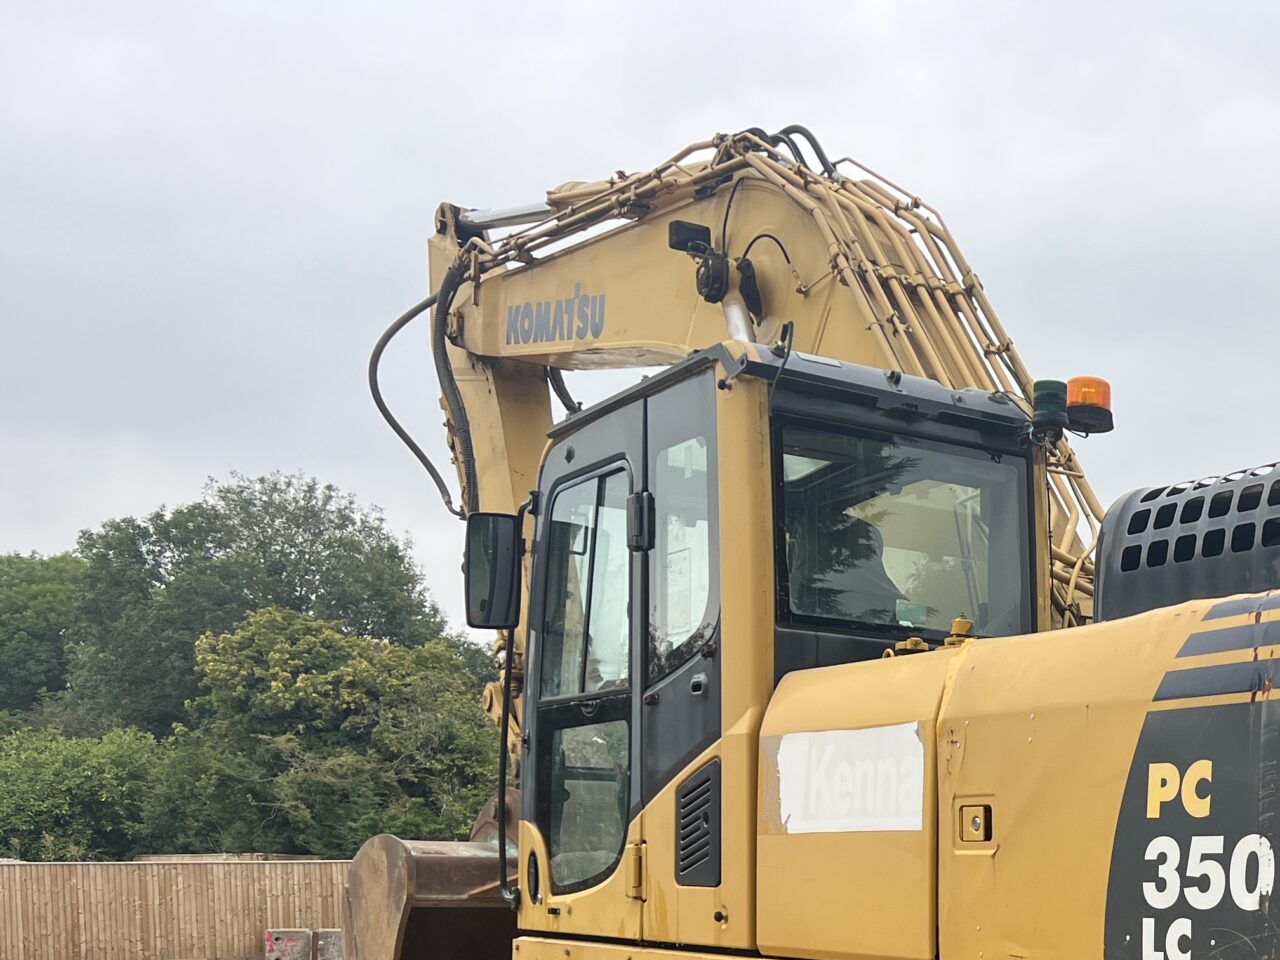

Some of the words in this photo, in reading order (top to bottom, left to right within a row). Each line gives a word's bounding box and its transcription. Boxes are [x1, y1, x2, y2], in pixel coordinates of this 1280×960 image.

[506, 282, 605, 345] KOMATSU
[1146, 759, 1213, 819] PC
[1142, 833, 1275, 911] 350
